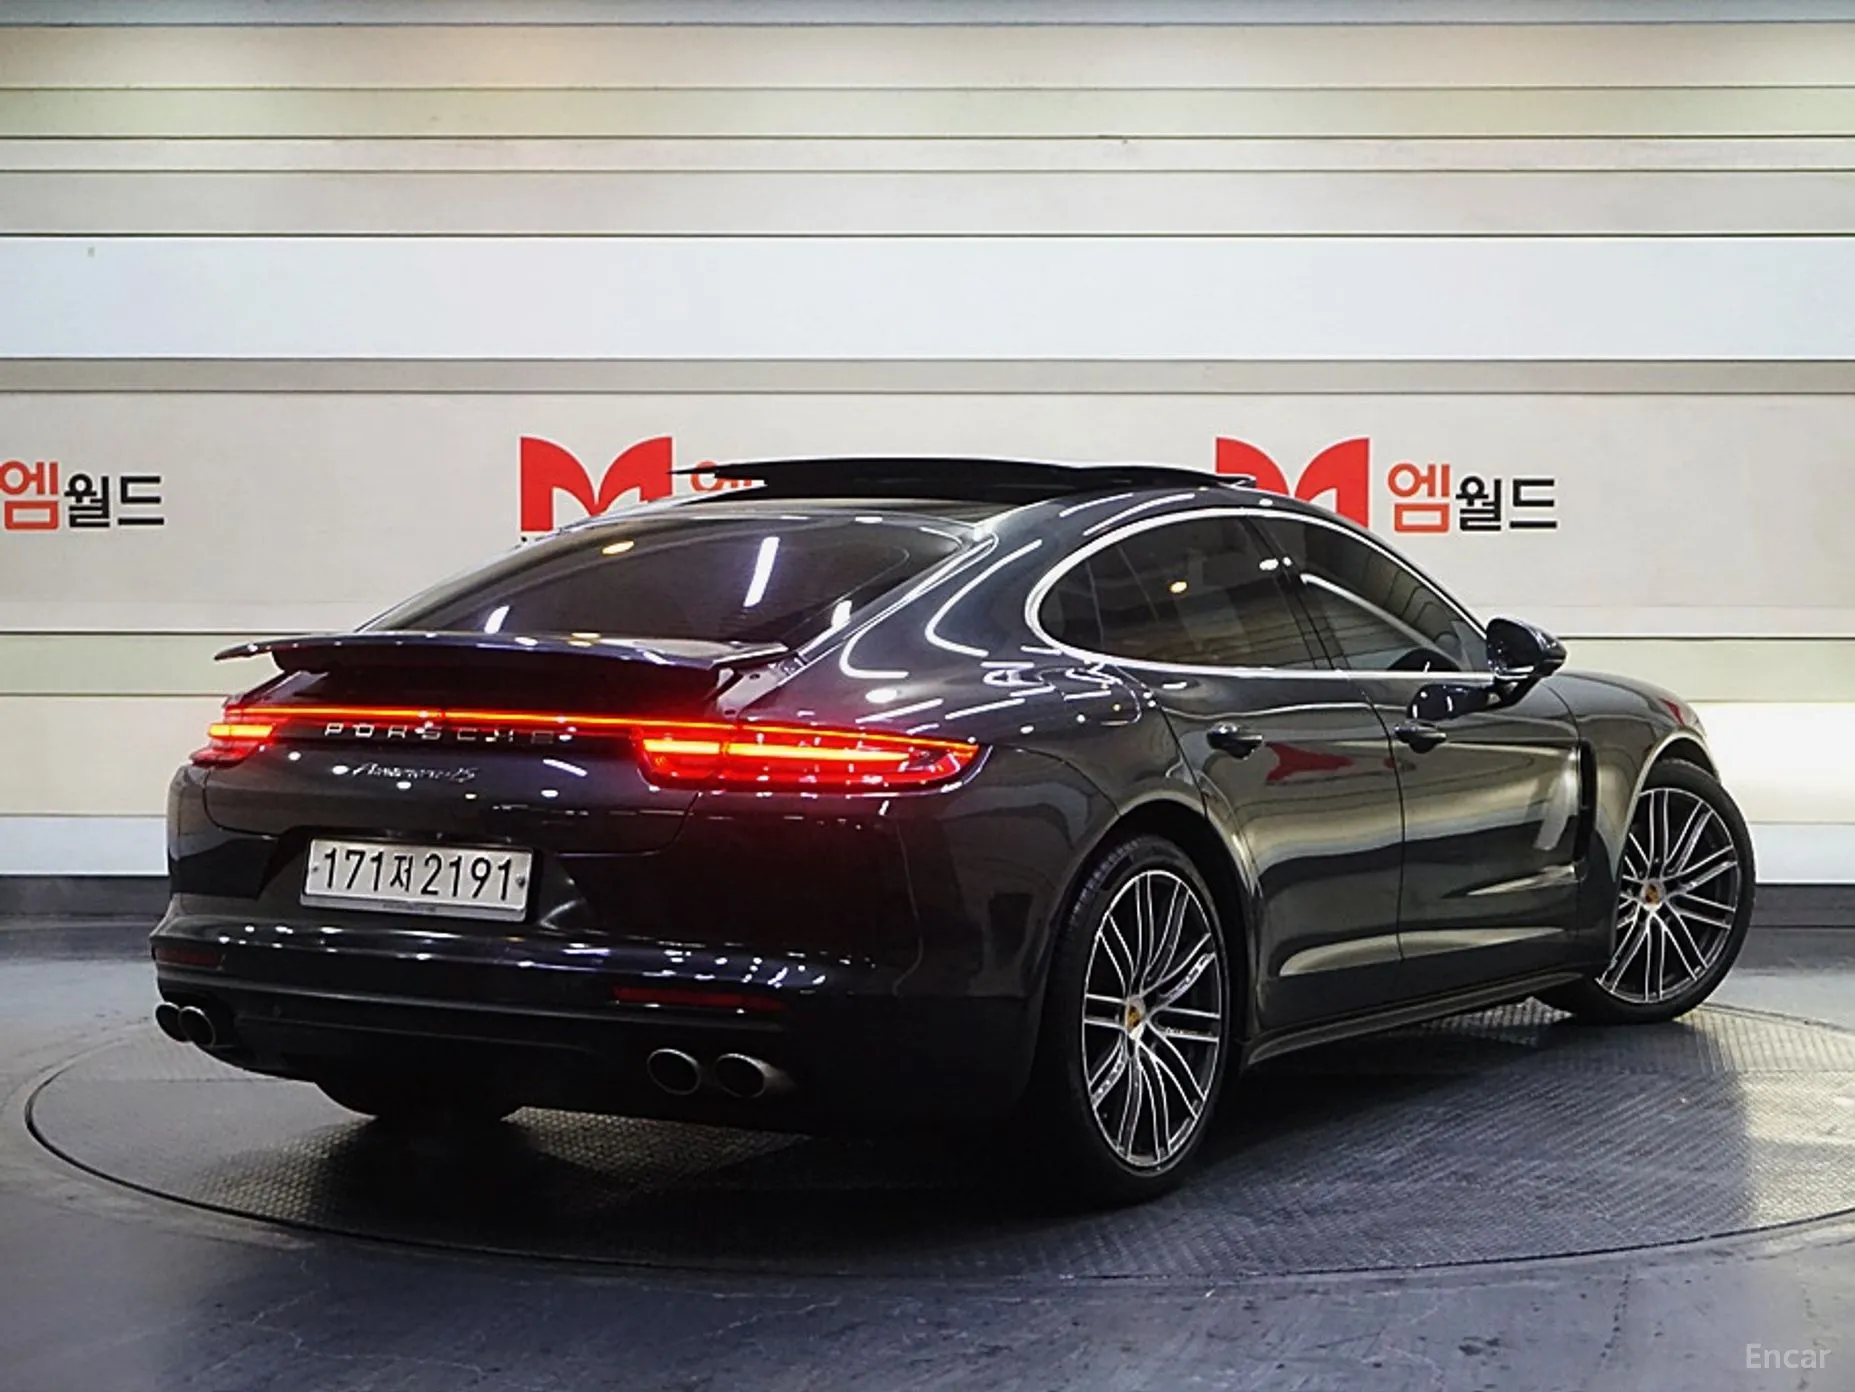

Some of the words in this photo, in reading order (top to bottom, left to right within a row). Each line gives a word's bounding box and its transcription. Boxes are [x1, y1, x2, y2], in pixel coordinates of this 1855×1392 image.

[0, 460, 165, 531] 엠월드
[1387, 462, 1558, 533] 엠월드
[324, 722, 555, 745] PORSCHE
[324, 847, 512, 901] 171저2191
